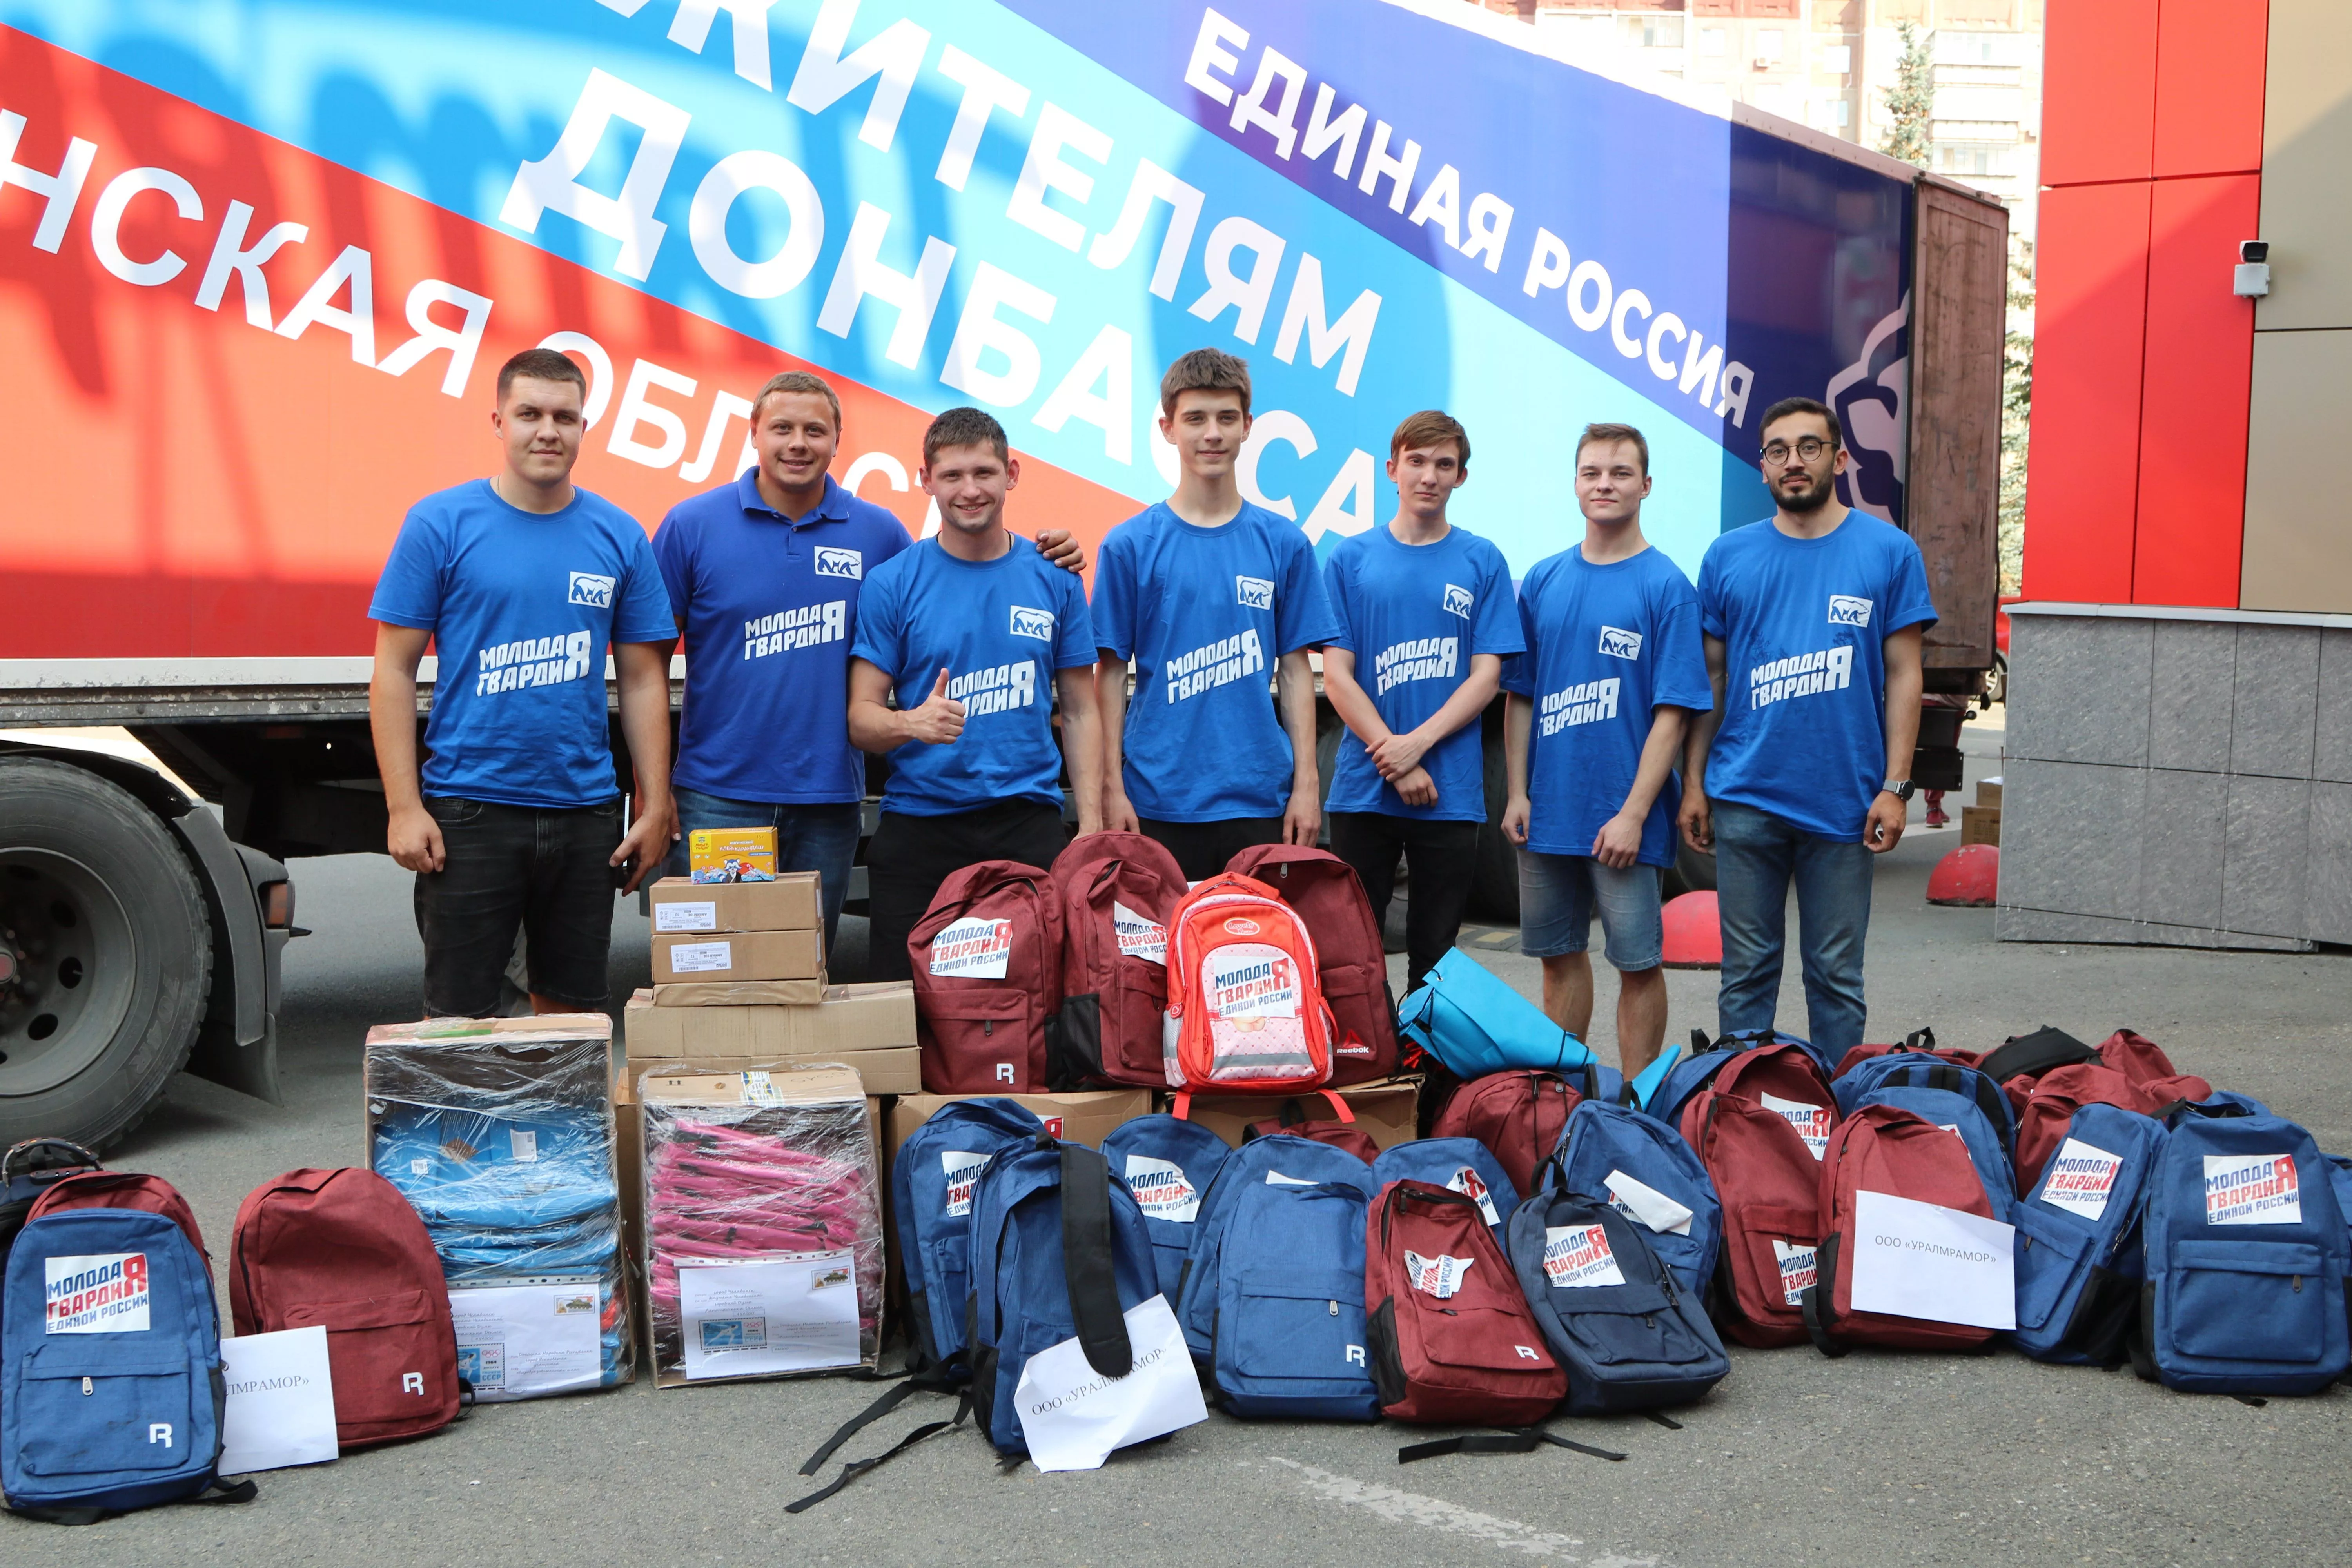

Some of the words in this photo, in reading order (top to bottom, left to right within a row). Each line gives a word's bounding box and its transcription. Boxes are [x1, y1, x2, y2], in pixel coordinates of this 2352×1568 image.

[1184, 7, 1514, 273] ЕДИНАЯ
[1523, 227, 1754, 428] РОССИЯ
[930, 957, 967, 973] ЕДИНОЙ
[971, 951, 1008, 966] РОССИИ
[1219, 998, 1256, 1016] ЕДИНОЙ
[1258, 990, 1292, 1005] РОССИИ
[1803, 1138, 1828, 1147] ОССИИ
[946, 1162, 988, 1187] МОЛОД
[1126, 1171, 1177, 1189] МОЛОД
[1133, 1185, 1188, 1203] ВАРДИ
[947, 1202, 970, 1215] ЕДИН
[2209, 1203, 2252, 1223] ЕДИНОЙ
[2256, 1191, 2298, 1211] РОССИИ
[1875, 1235, 1901, 1247] ООО
[1905, 1240, 1996, 1263] «УРАЛМРАМОР»
[1551, 1269, 1582, 1286] ЕДИНОЙ
[1584, 1257, 1616, 1277] РОССИИ
[1782, 1269, 1817, 1292] ГВАРДИ
[47, 1310, 97, 1332] ЕДИНОЙ
[101, 1293, 148, 1319] РОССИИ
[1032, 1397, 1062, 1415] ООО
